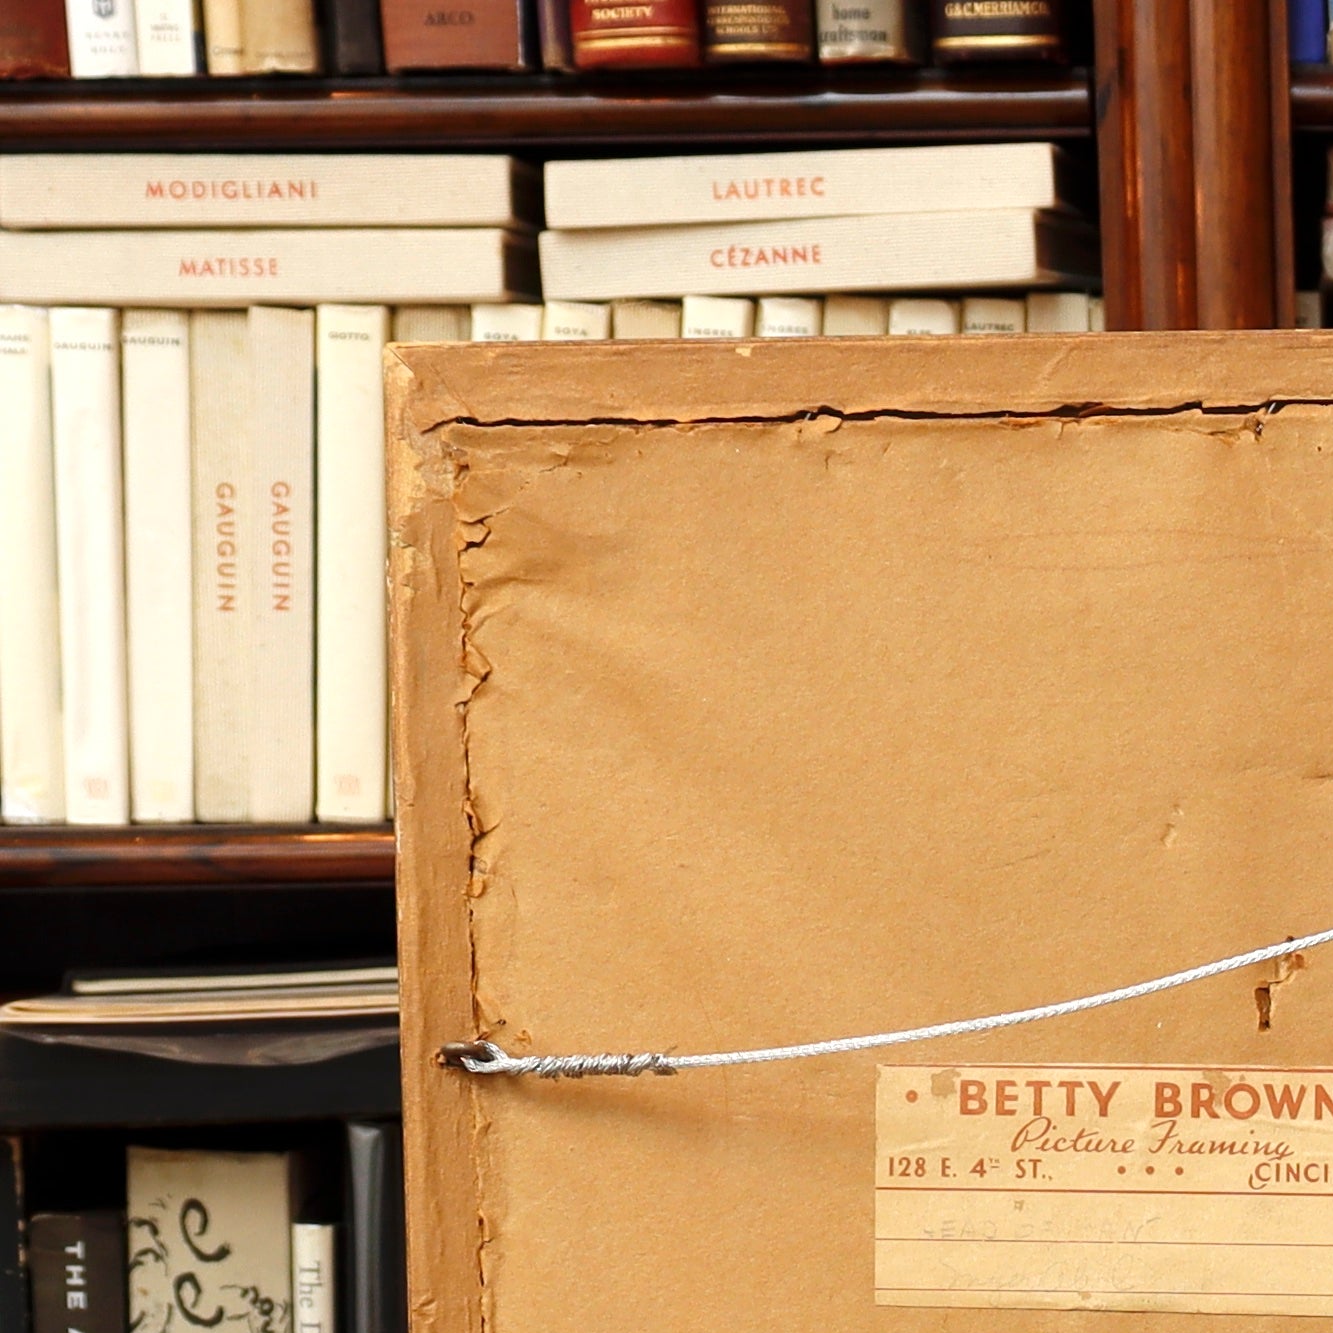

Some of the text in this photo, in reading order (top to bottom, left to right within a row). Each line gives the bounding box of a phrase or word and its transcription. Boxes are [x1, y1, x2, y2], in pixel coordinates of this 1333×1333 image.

[591, 6, 655, 22] SOCIETY
[832, 5, 871, 21] home
[144, 180, 320, 200] MODIGLIANI
[711, 175, 826, 201] LAUTREC
[709, 243, 823, 268] CÉZANNE
[178, 257, 280, 277] MATISSE
[554, 325, 589, 338] GOYA
[963, 321, 1016, 332] LAUTREC
[54, 341, 113, 352] GAUGUIN
[121, 335, 181, 347] GAUGUIN
[214, 480, 237, 613] GAUGUIN
[270, 480, 291, 612] GAUGUIN
[958, 1079, 1122, 1118] BETTY
[1010, 1116, 1296, 1161] Picture Framing
[886, 1156, 927, 1178] 128
[939, 1157, 959, 1178] E.
[64, 1240, 86, 1311] THE
[299, 1261, 322, 1310] The
